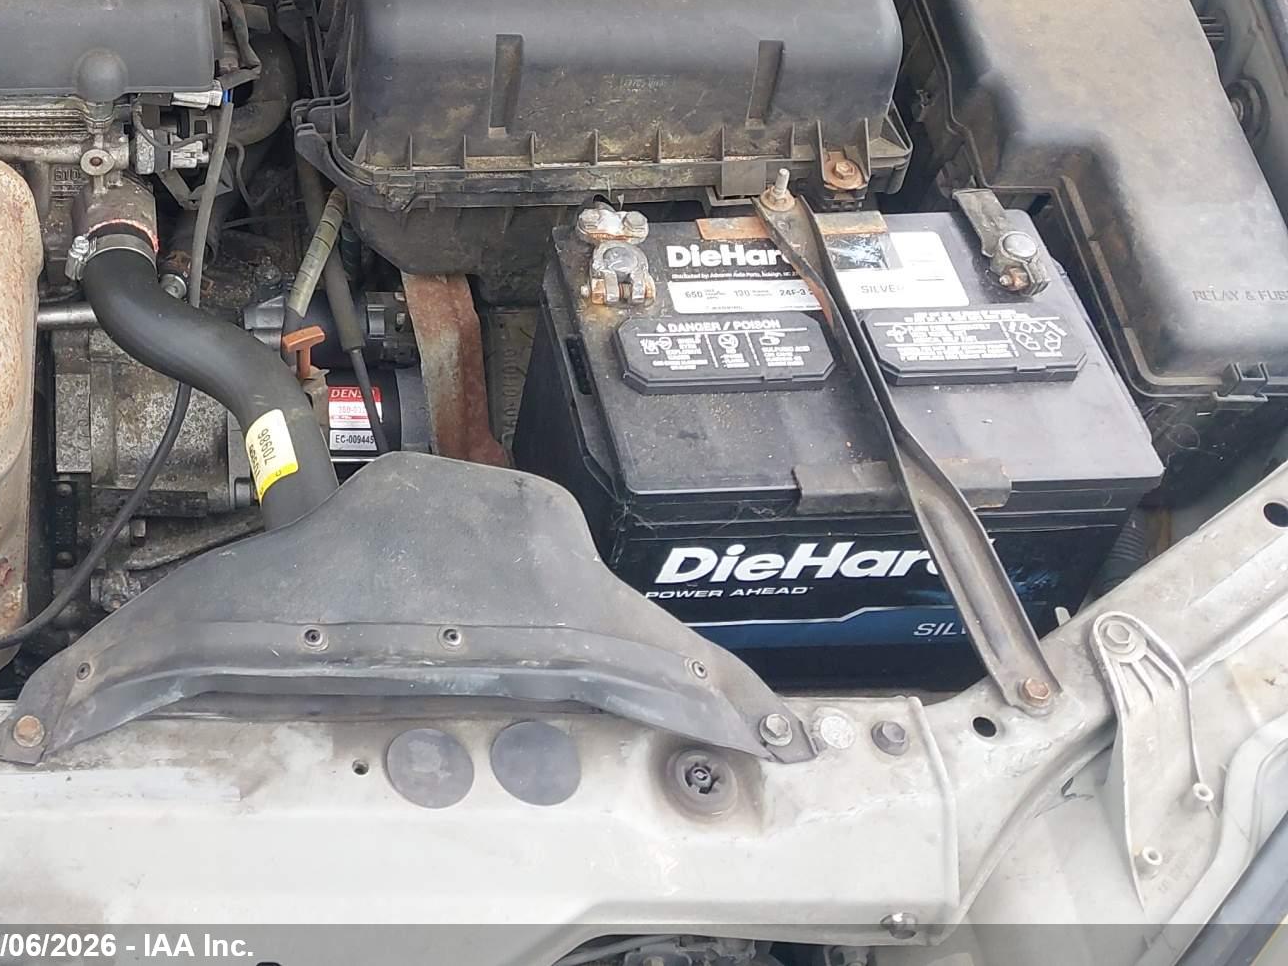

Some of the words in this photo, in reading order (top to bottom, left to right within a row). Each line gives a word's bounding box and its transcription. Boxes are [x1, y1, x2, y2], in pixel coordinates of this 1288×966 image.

[666, 244, 792, 268] DieHar
[1192, 290, 1239, 302] RELAY
[1258, 290, 1288, 302] FUS
[668, 322, 722, 333] DANGER
[734, 319, 781, 331] POISON
[654, 541, 942, 584] DieHar
[645, 588, 723, 599] POWER
[729, 586, 809, 597] AHEAD
